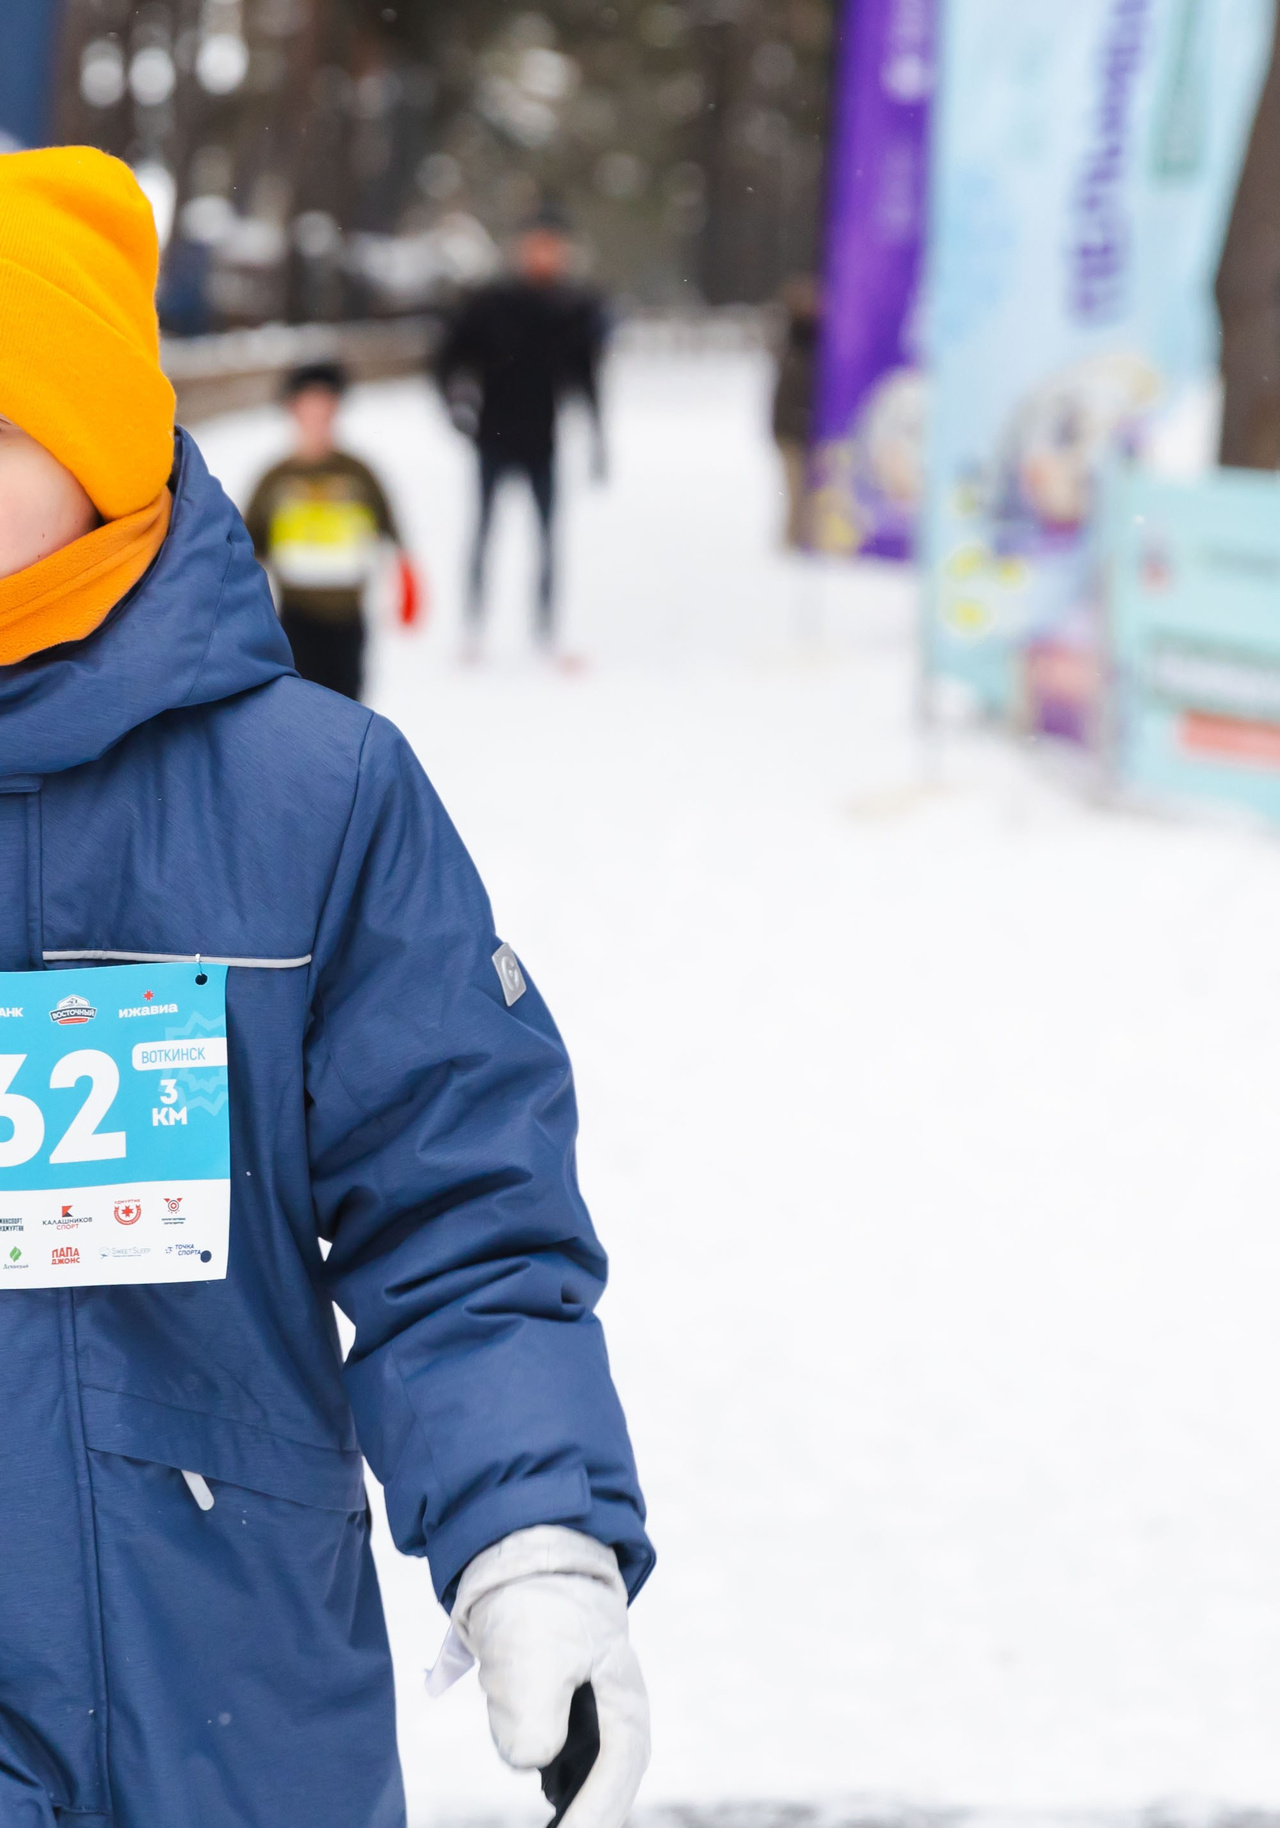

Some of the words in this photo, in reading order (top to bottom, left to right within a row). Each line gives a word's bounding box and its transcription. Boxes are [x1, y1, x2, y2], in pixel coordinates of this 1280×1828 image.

[51, 1008, 96, 1020] ВОСТОЧНЫЙ
[141, 1047, 206, 1064] ВОТКИНСК
[159, 1078, 179, 1105] 3
[151, 1106, 188, 1127] КМ
[42, 1216, 93, 1226] КАЛАШНИКОВ
[56, 1223, 79, 1231] СПОРТ
[52, 1247, 80, 1258] ПАПА
[51, 1257, 81, 1265] ДЖОНС
